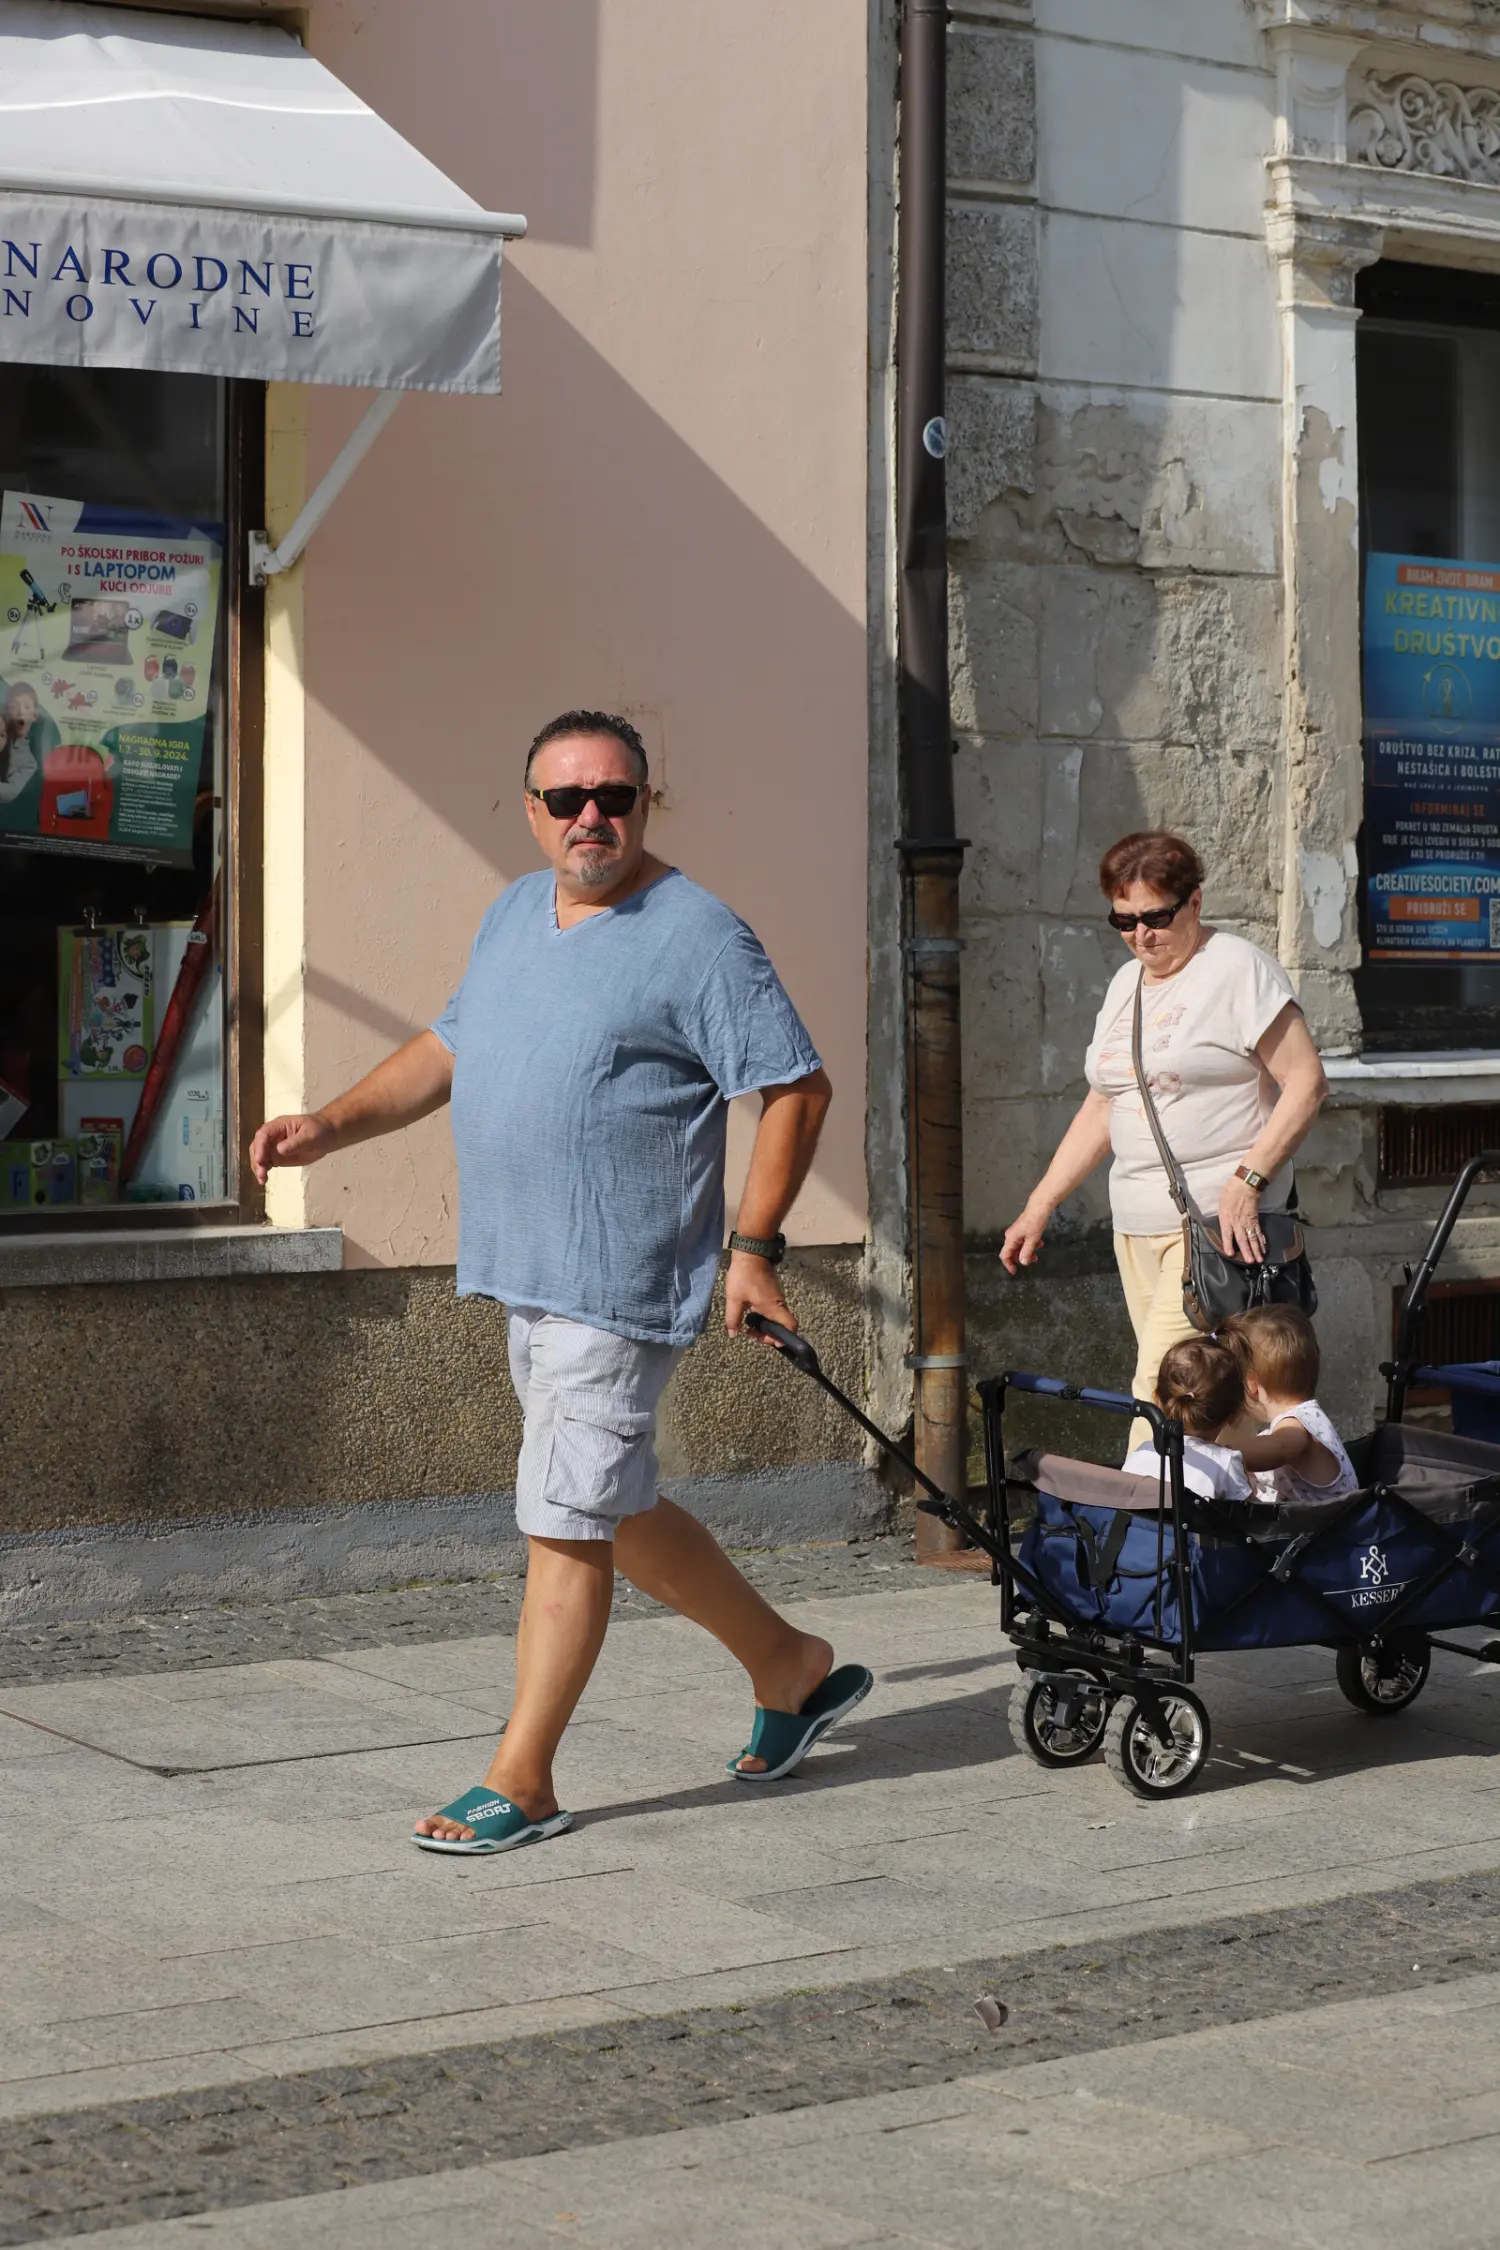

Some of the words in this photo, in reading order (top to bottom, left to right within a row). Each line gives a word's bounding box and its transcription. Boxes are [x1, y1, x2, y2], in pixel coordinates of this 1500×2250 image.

[2, 239, 315, 299] NARODNE
[2, 288, 315, 338] NOVINE
[61, 547, 75, 557] PO
[78, 545, 123, 560] ŠKOLSKI
[126, 550, 166, 562] PRIBOR
[169, 553, 204, 564] POŽURI
[68, 564, 71, 575] I
[74, 564, 81, 575] S
[84, 561, 176, 581] LAPTOPOM
[1385, 590, 1500, 623] KREATIVN
[1395, 627, 1500, 661] DRUŠTVO
[119, 734, 167, 747] NAGRADNA
[169, 740, 190, 750] IGRA
[1379, 740, 1424, 756] DRUŠTVO
[1427, 744, 1444, 757] BEZ
[1397, 759, 1450, 776] NESTAŠICA
[1454, 764, 1457, 777] I
[1473, 803, 1485, 817] SE
[1376, 873, 1500, 894] CREATIVESOCIETY.COM
[1406, 900, 1451, 916] PRIDRUŽI
[1454, 902, 1467, 916] SE
[467, 1799, 500, 1815] FASHION
